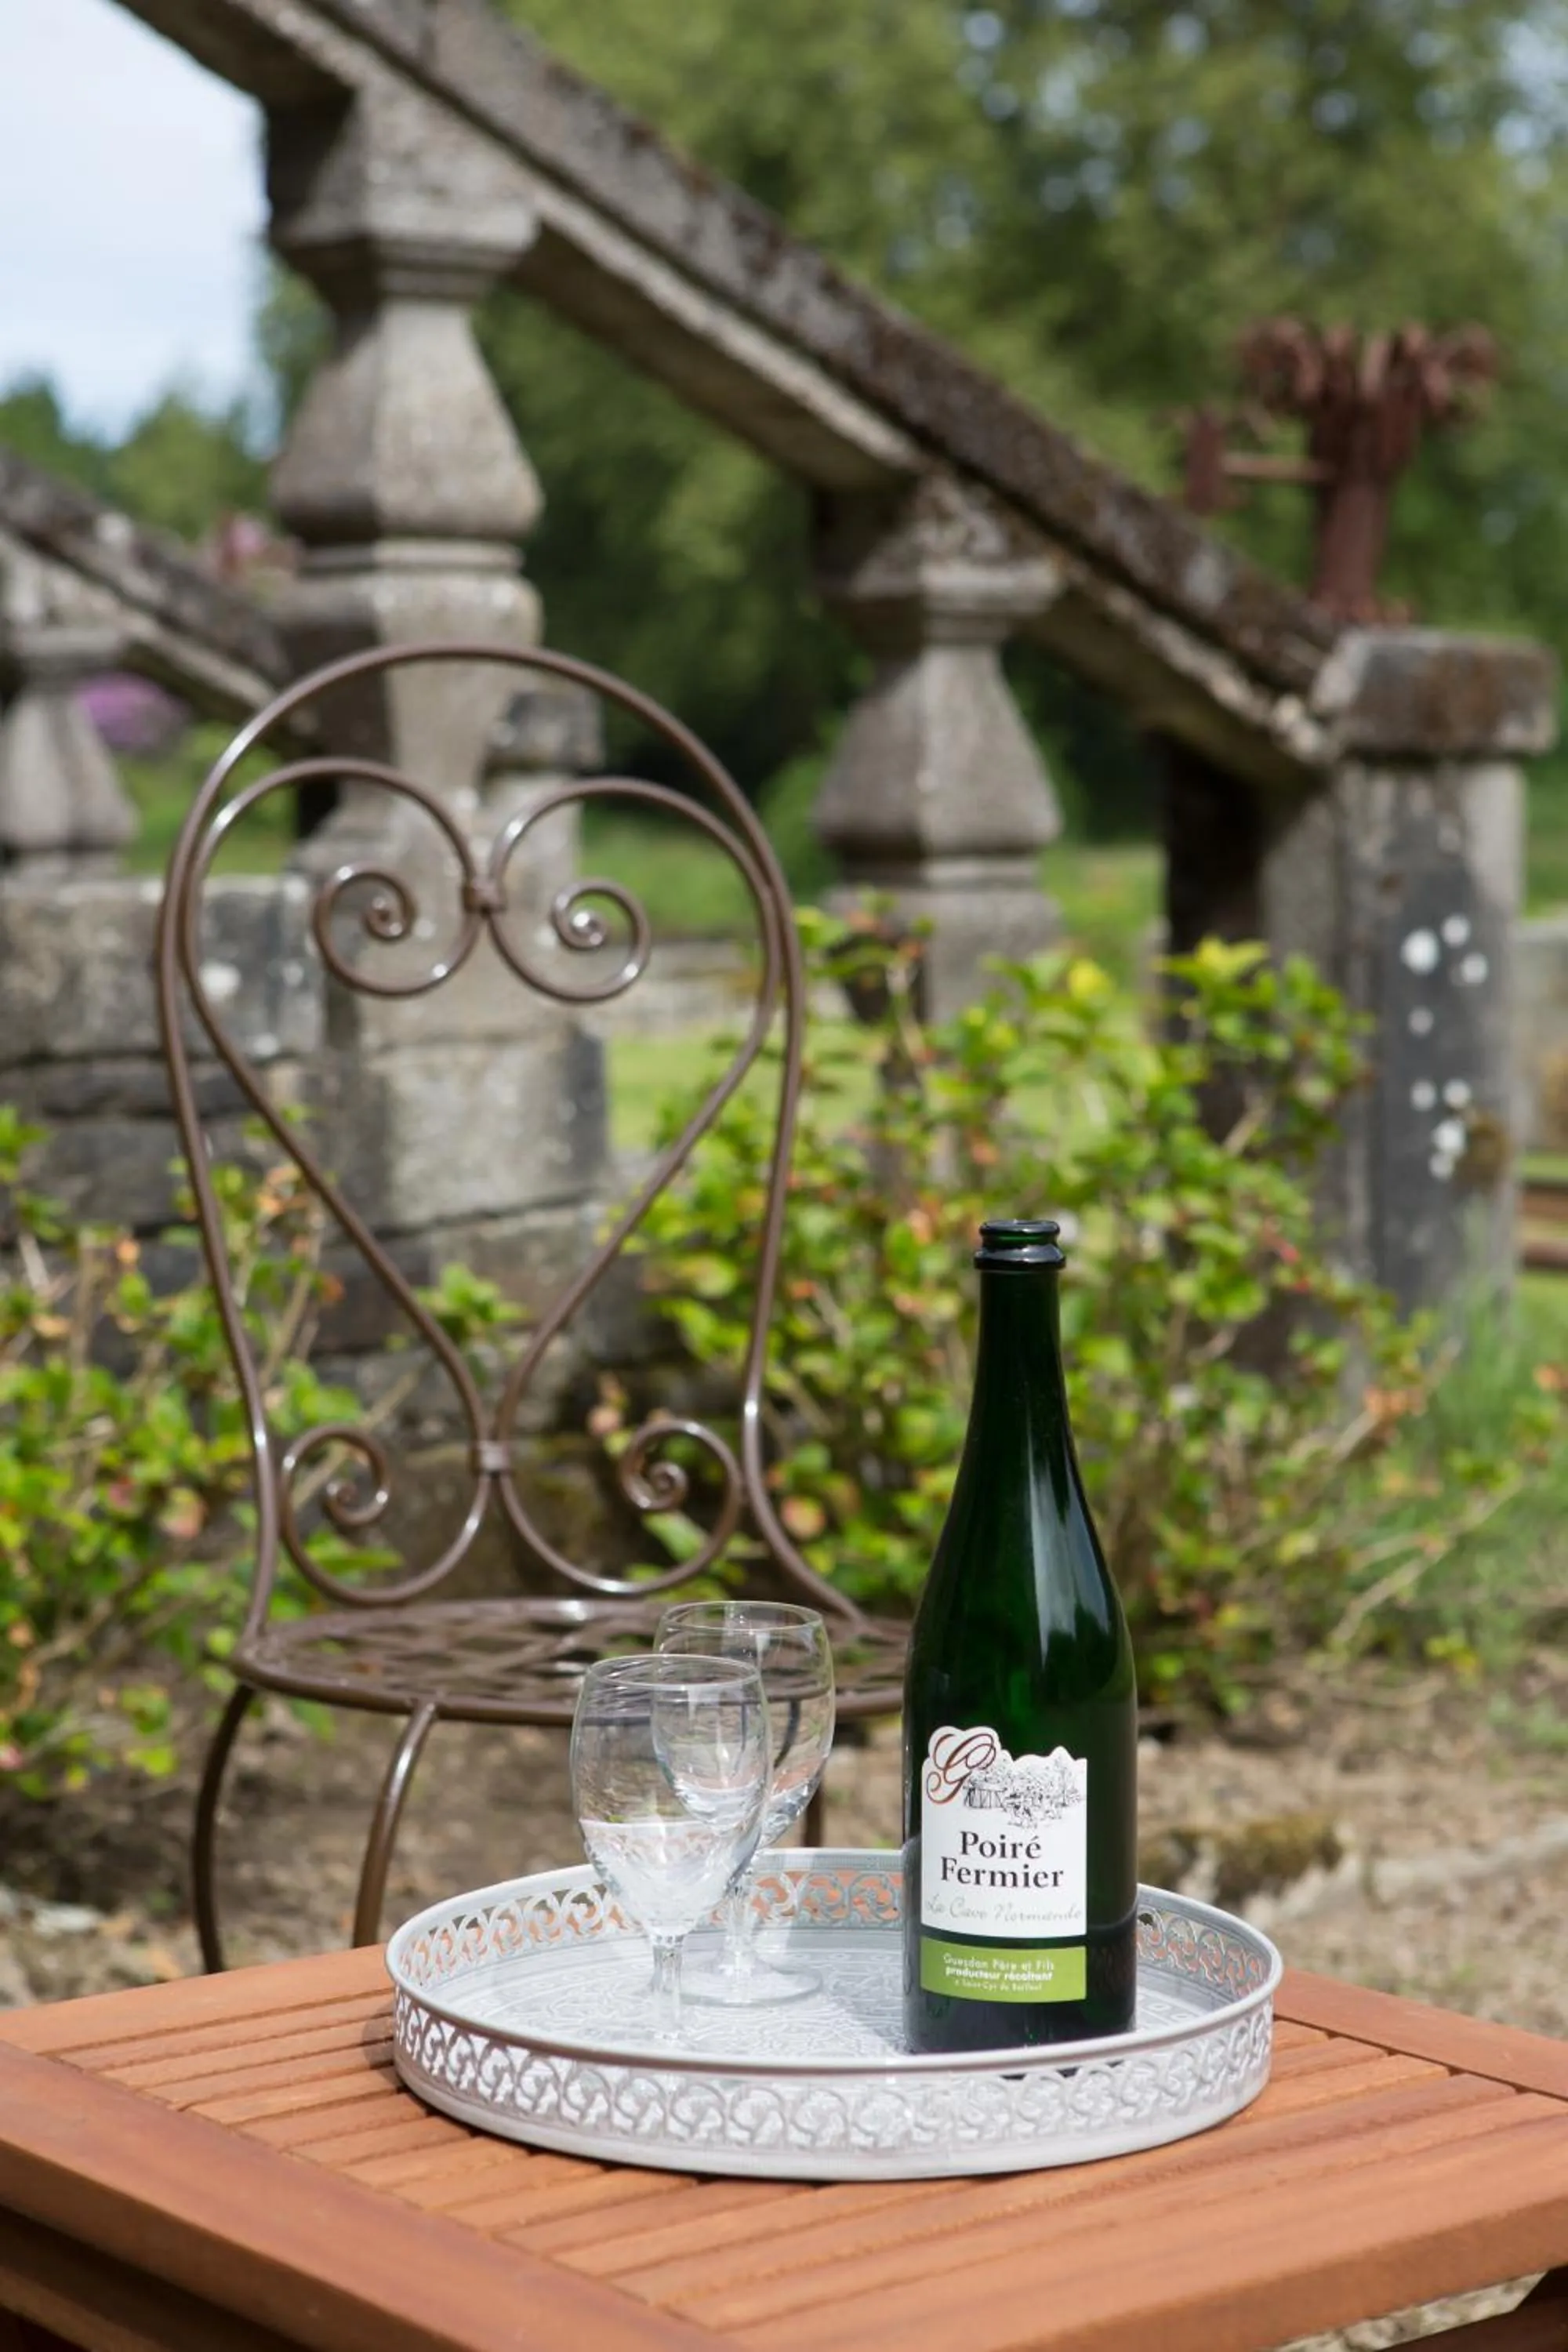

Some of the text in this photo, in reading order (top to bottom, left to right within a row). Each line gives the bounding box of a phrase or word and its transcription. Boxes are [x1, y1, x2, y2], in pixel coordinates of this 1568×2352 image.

[960, 1831, 1041, 1859] Poiré
[941, 1856, 1064, 1888] Fermier
[926, 1893, 1082, 1923] La Cave Normande
[946, 1966, 1053, 1982] producteur récoltant
[993, 1958, 1018, 1970] Père
[1022, 1962, 1032, 1970] et
[1036, 1958, 1054, 1970] Fils
